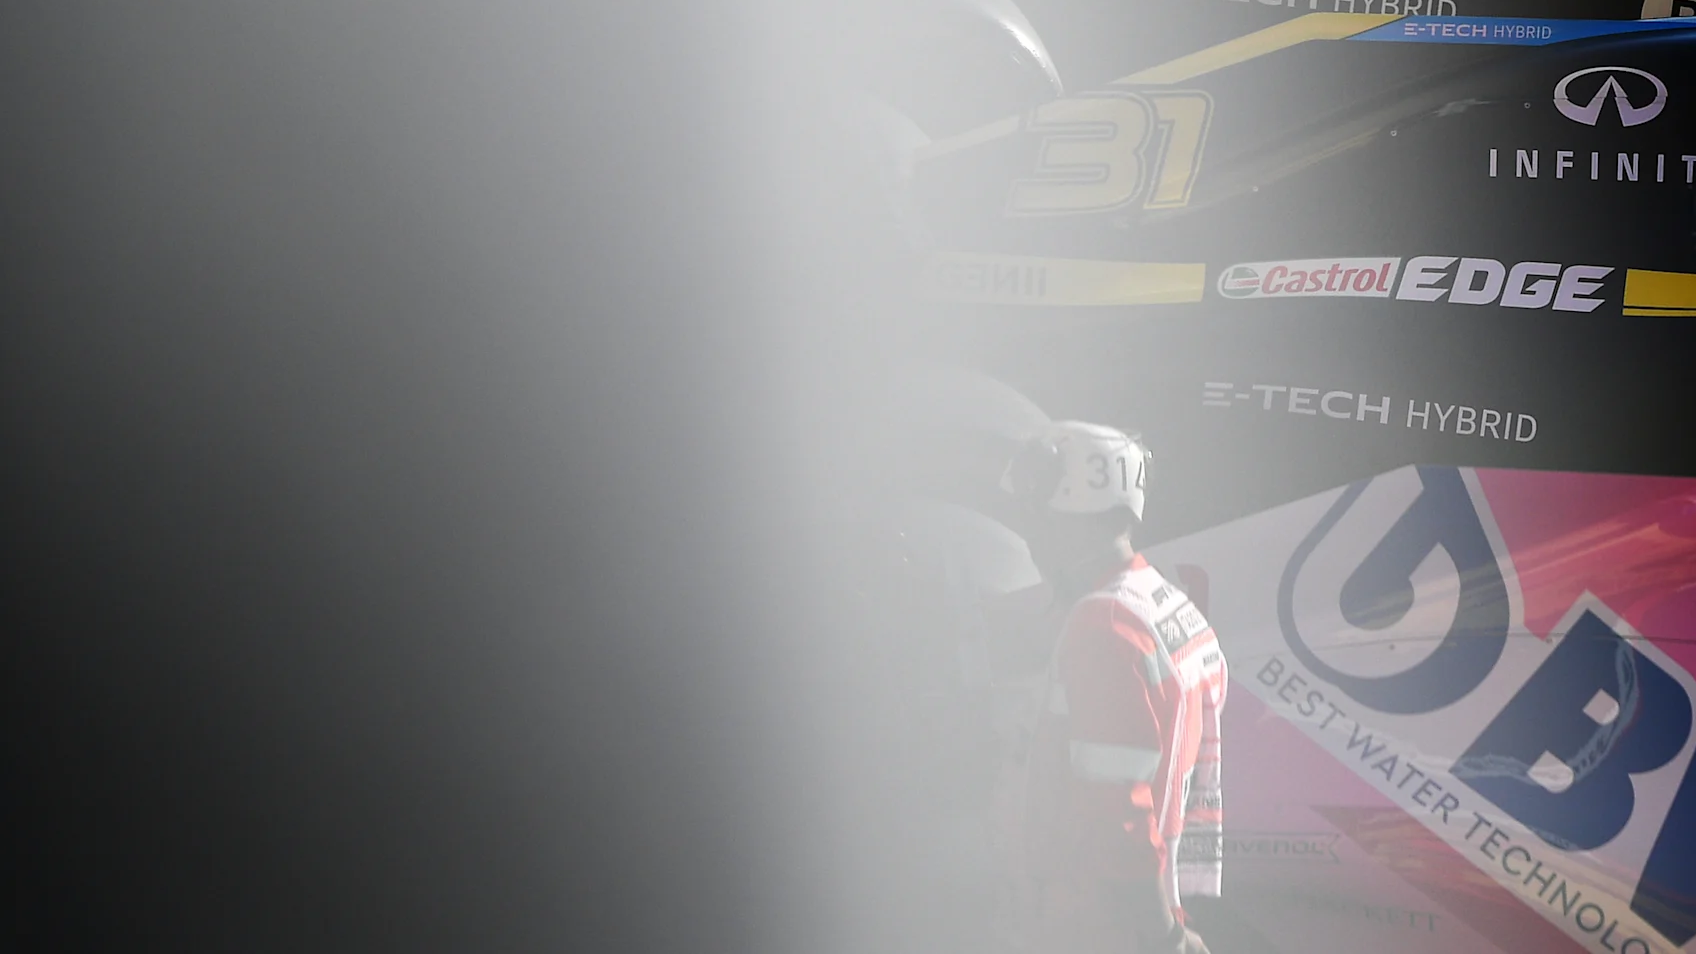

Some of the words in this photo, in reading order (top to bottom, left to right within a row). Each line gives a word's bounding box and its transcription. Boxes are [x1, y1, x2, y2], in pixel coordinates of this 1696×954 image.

[1404, 22, 1488, 38] E-TECH
[1493, 25, 1552, 41] HYBRID
[1003, 91, 1214, 217] 31
[1262, 261, 1389, 295] Castrol
[1396, 256, 1615, 313] EDGE
[1202, 381, 1390, 425] E-TECH
[1406, 400, 1538, 443] HYBRID
[1257, 657, 1345, 734] BEST
[1344, 722, 1461, 825] WATER
